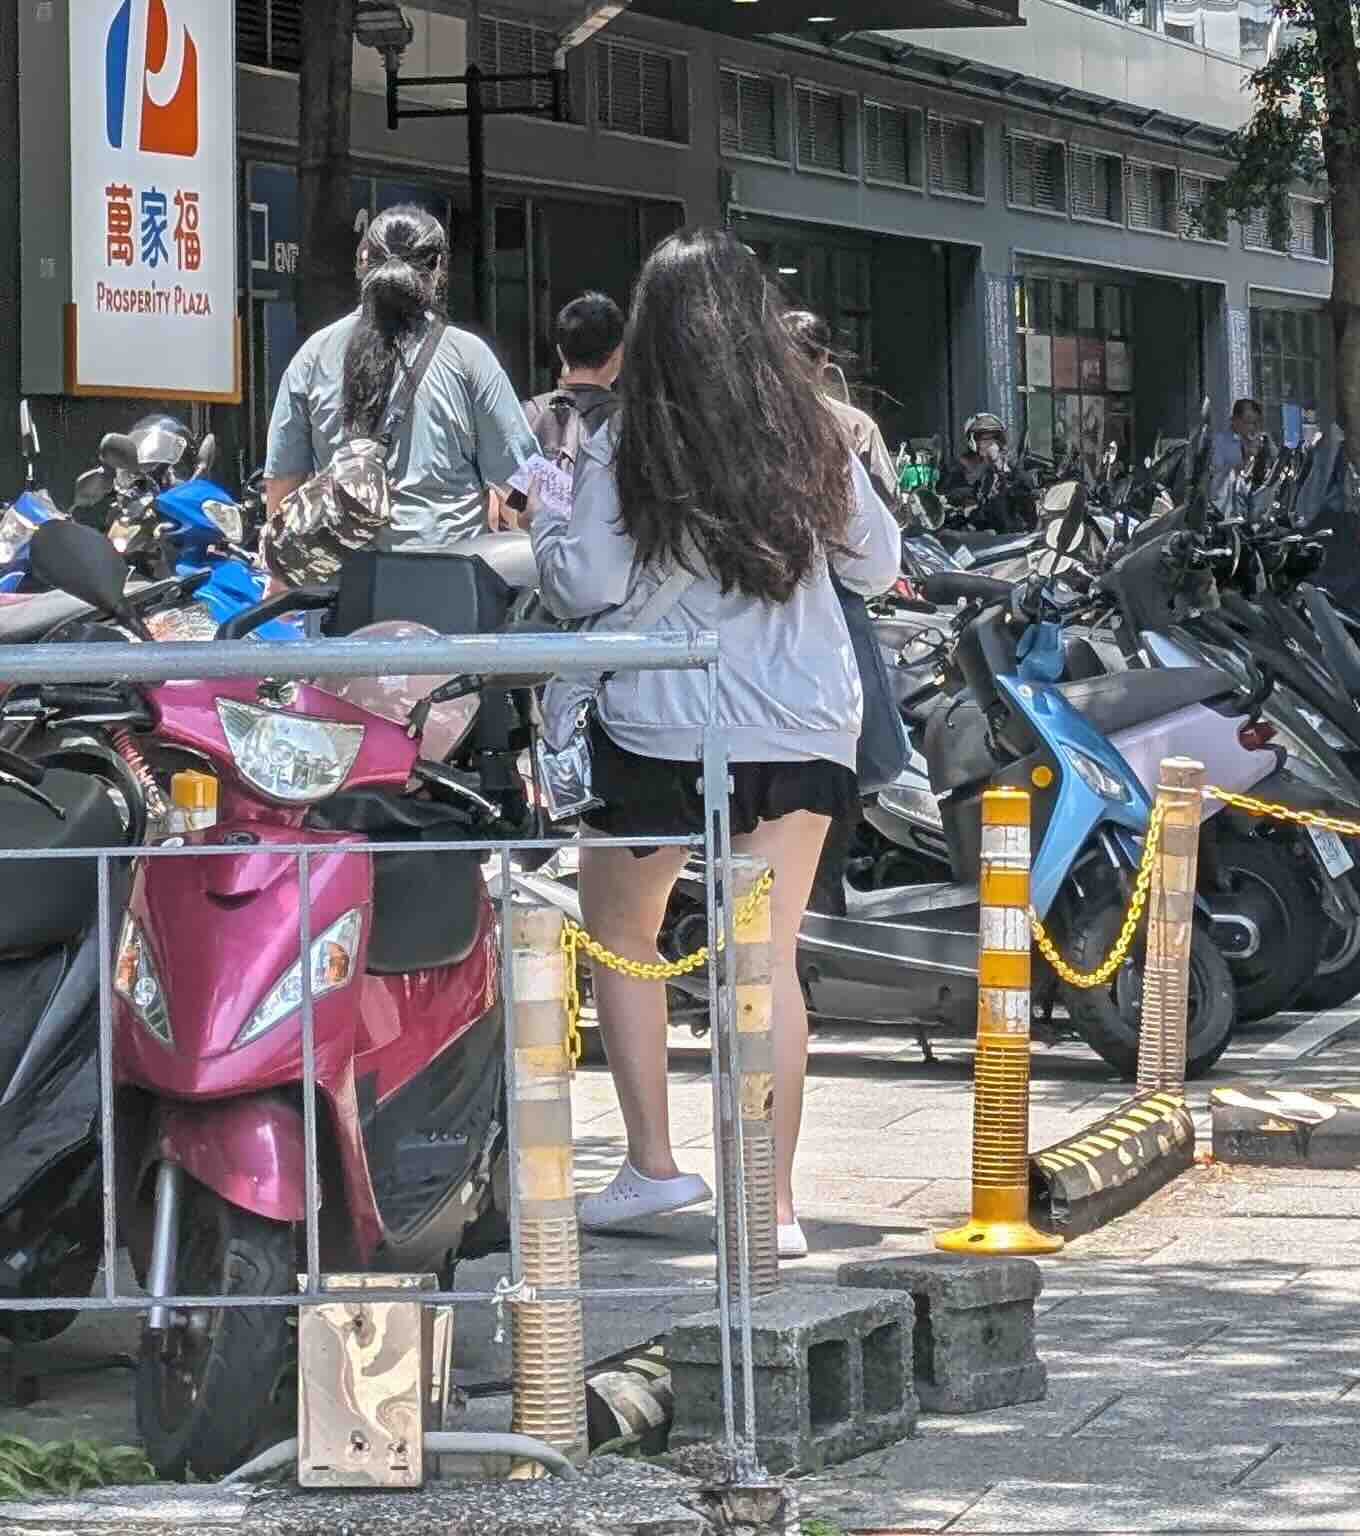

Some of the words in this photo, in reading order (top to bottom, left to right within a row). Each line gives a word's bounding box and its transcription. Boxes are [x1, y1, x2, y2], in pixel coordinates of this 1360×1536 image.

[105, 182, 202, 272] 萬家福
[96, 279, 171, 314] PROSPERITY
[174, 284, 212, 316] PLAZA
